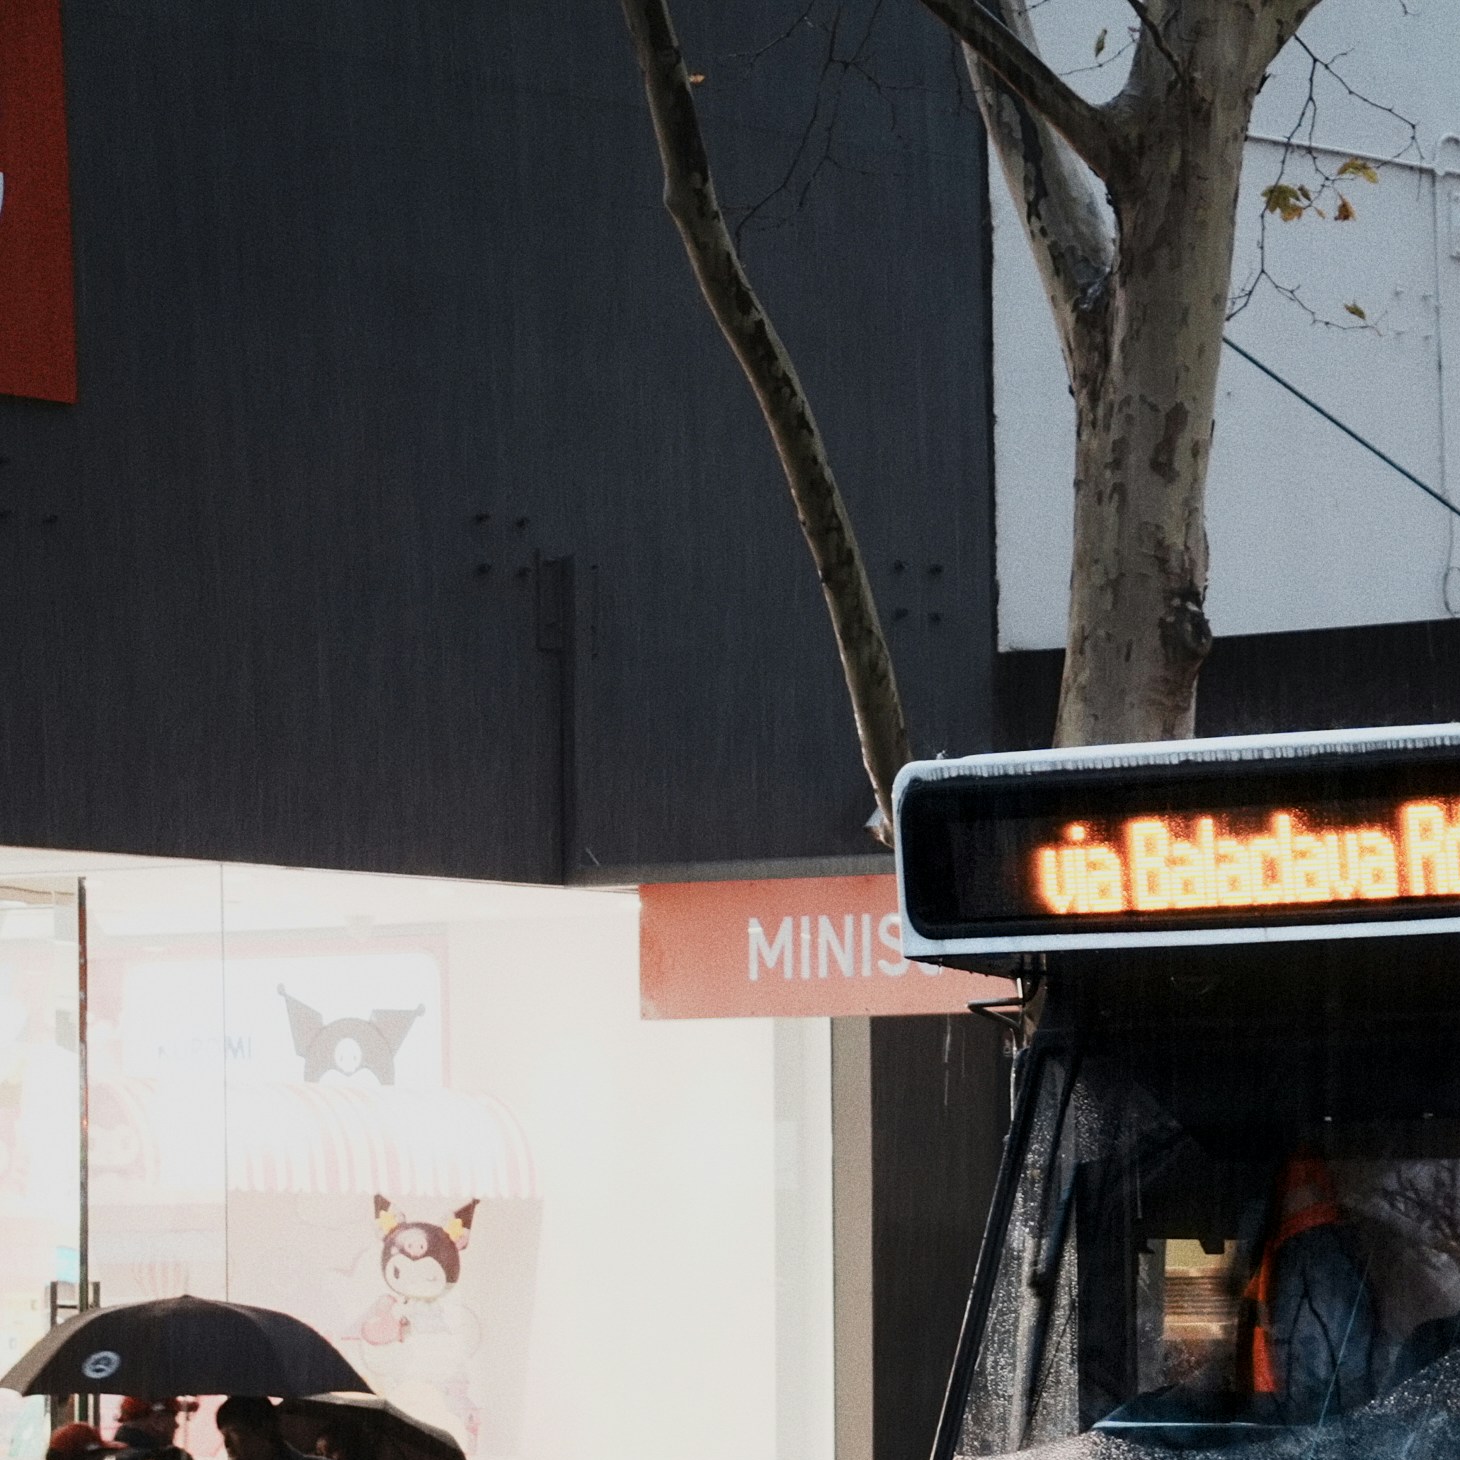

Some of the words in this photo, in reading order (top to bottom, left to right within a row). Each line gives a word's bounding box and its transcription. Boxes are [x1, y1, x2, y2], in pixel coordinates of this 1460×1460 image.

[1040, 822, 1123, 914] via
[1126, 811, 1400, 911] Balaclava
[748, 912, 945, 981] MINIS
